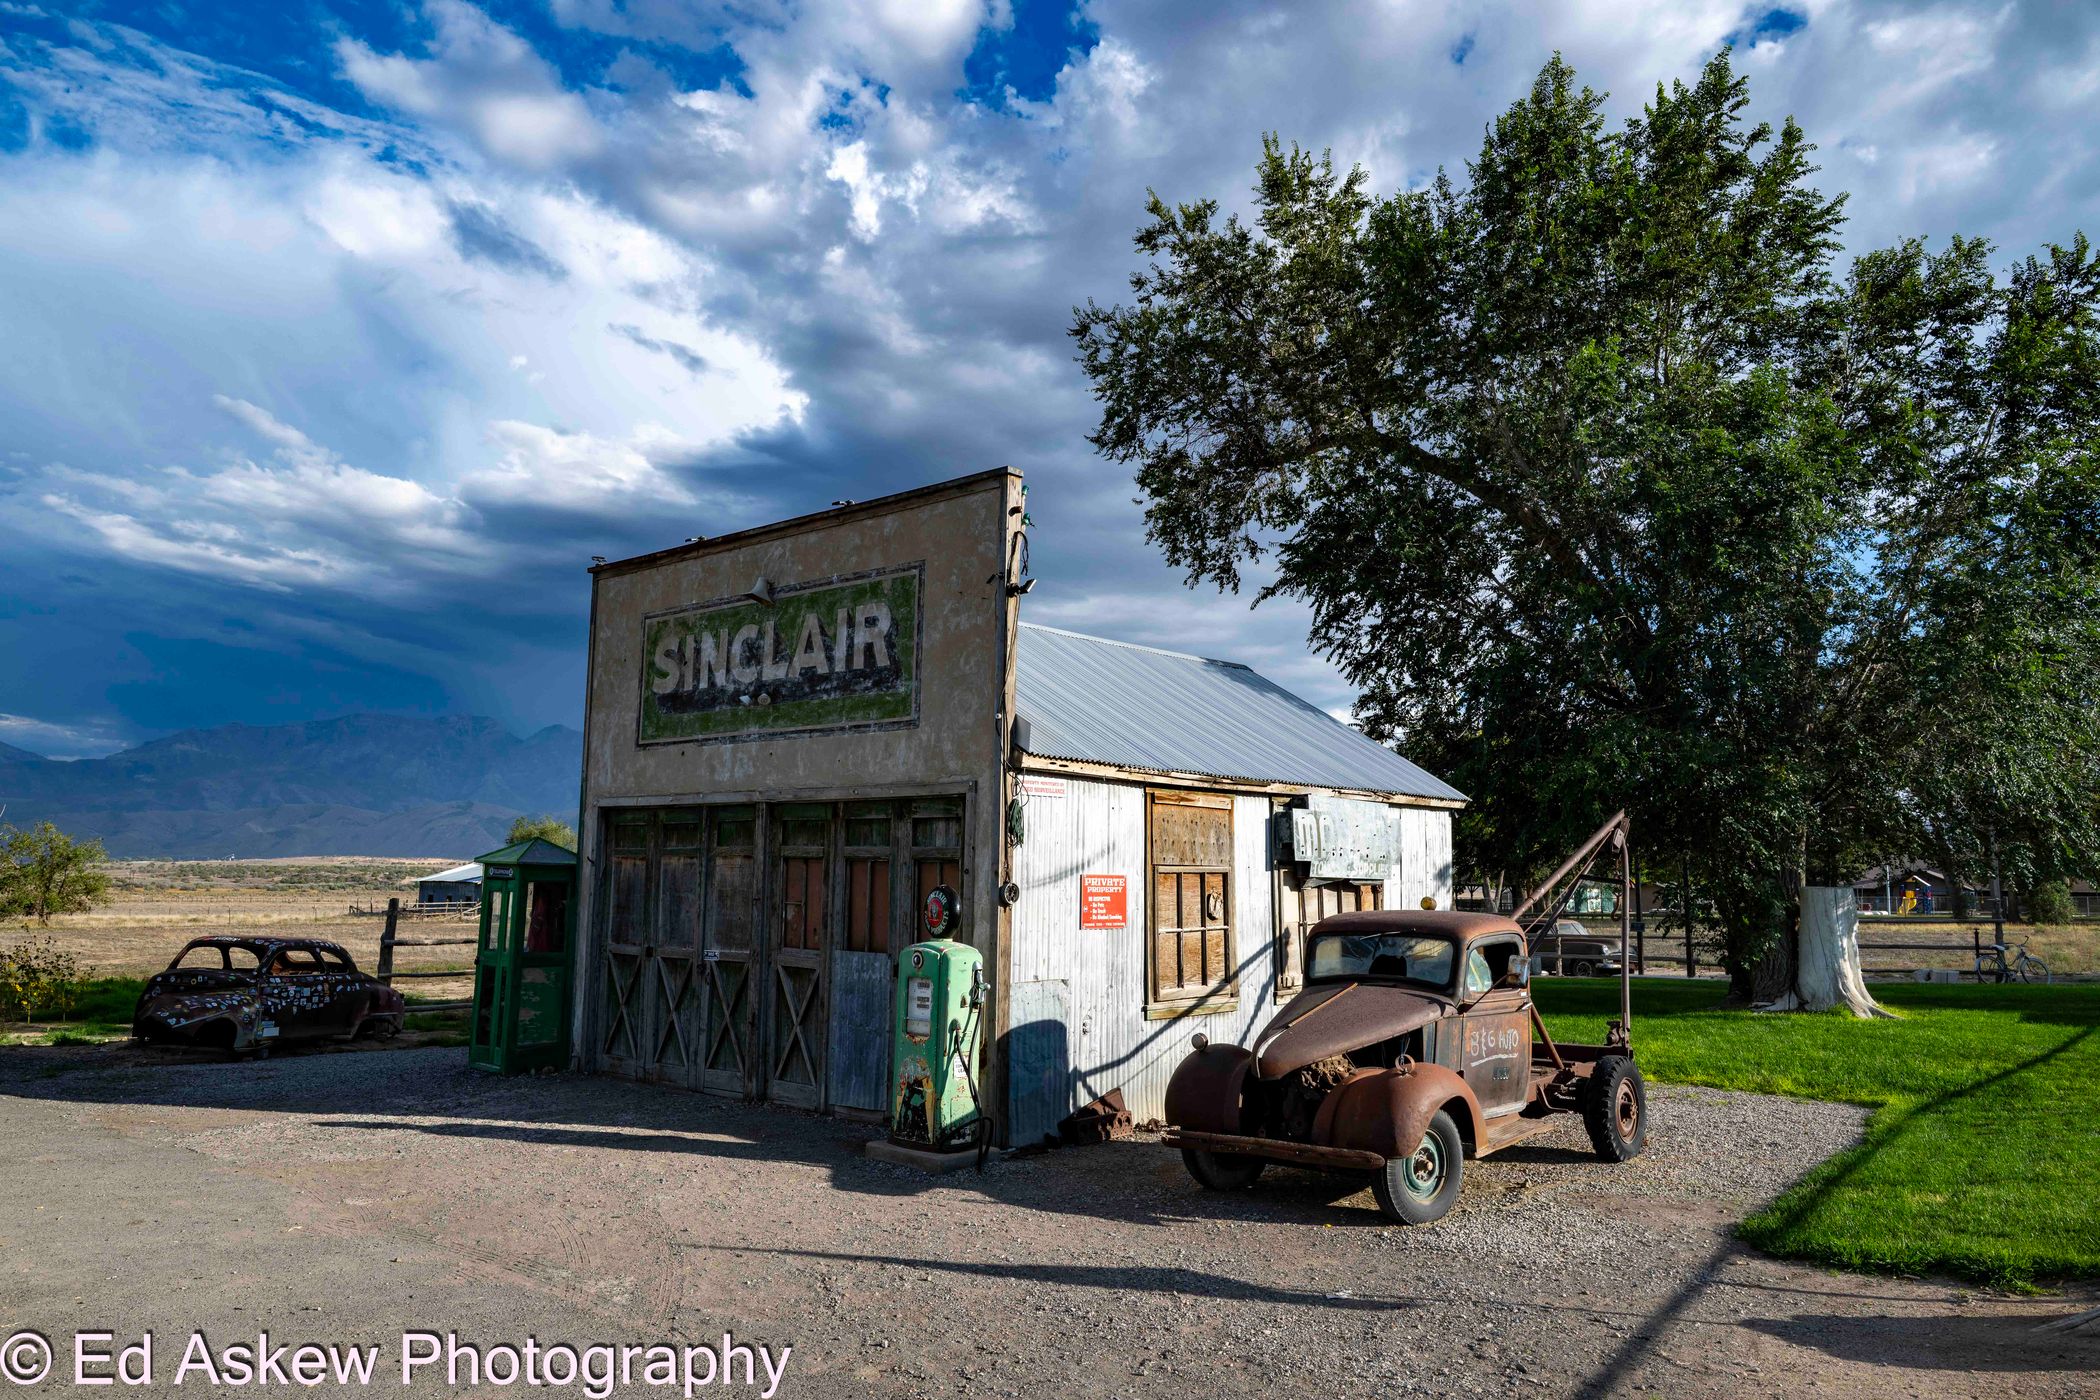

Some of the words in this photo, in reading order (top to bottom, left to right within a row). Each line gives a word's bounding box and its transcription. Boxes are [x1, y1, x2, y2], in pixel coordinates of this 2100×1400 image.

[652, 602, 892, 695] SINCLAIR
[1085, 877, 1125, 887] PRIVATE
[1498, 1029, 1519, 1051] AUTO
